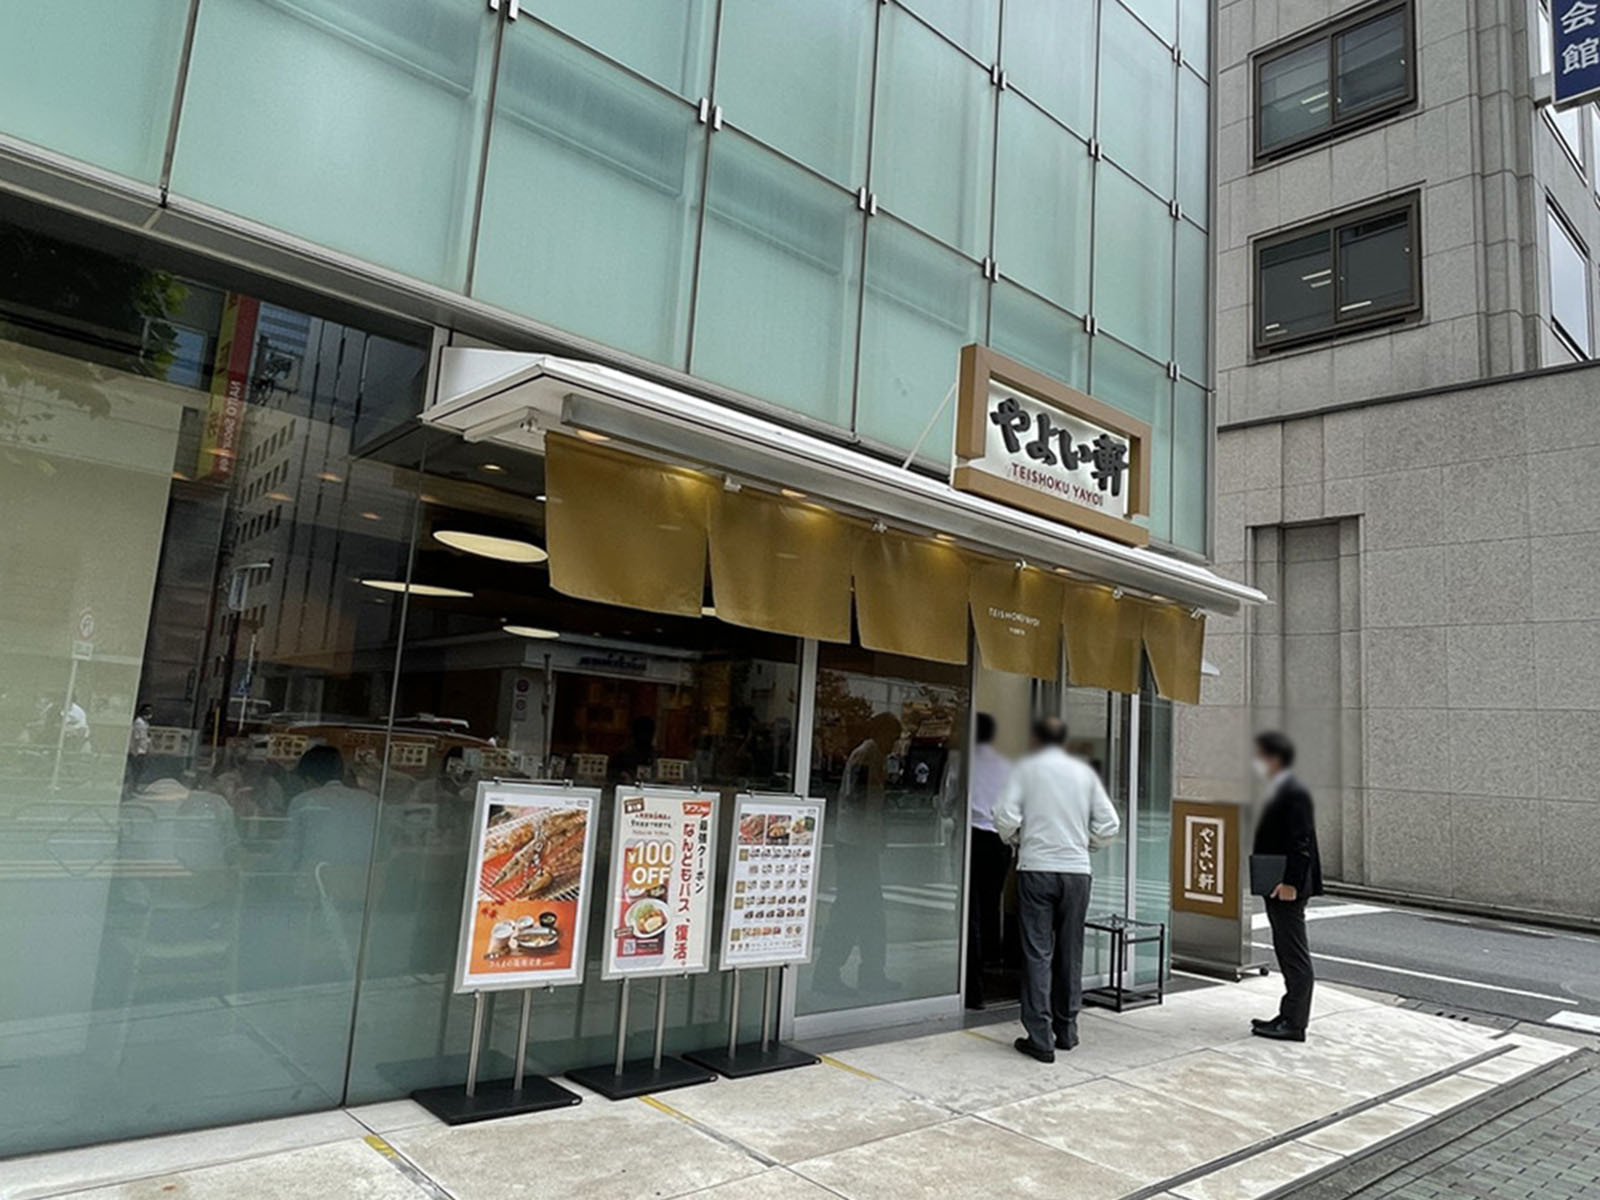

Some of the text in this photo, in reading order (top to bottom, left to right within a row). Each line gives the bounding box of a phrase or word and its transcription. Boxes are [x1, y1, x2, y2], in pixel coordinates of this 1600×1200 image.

[1560, 1, 1600, 75] 会館
[989, 397, 1130, 498] やよい軒
[1011, 462, 1104, 507] TEISHOKU YAYOI
[628, 841, 675, 865] ¥100
[632, 866, 673, 884] OFF
[1199, 827, 1216, 891] やよい軒
